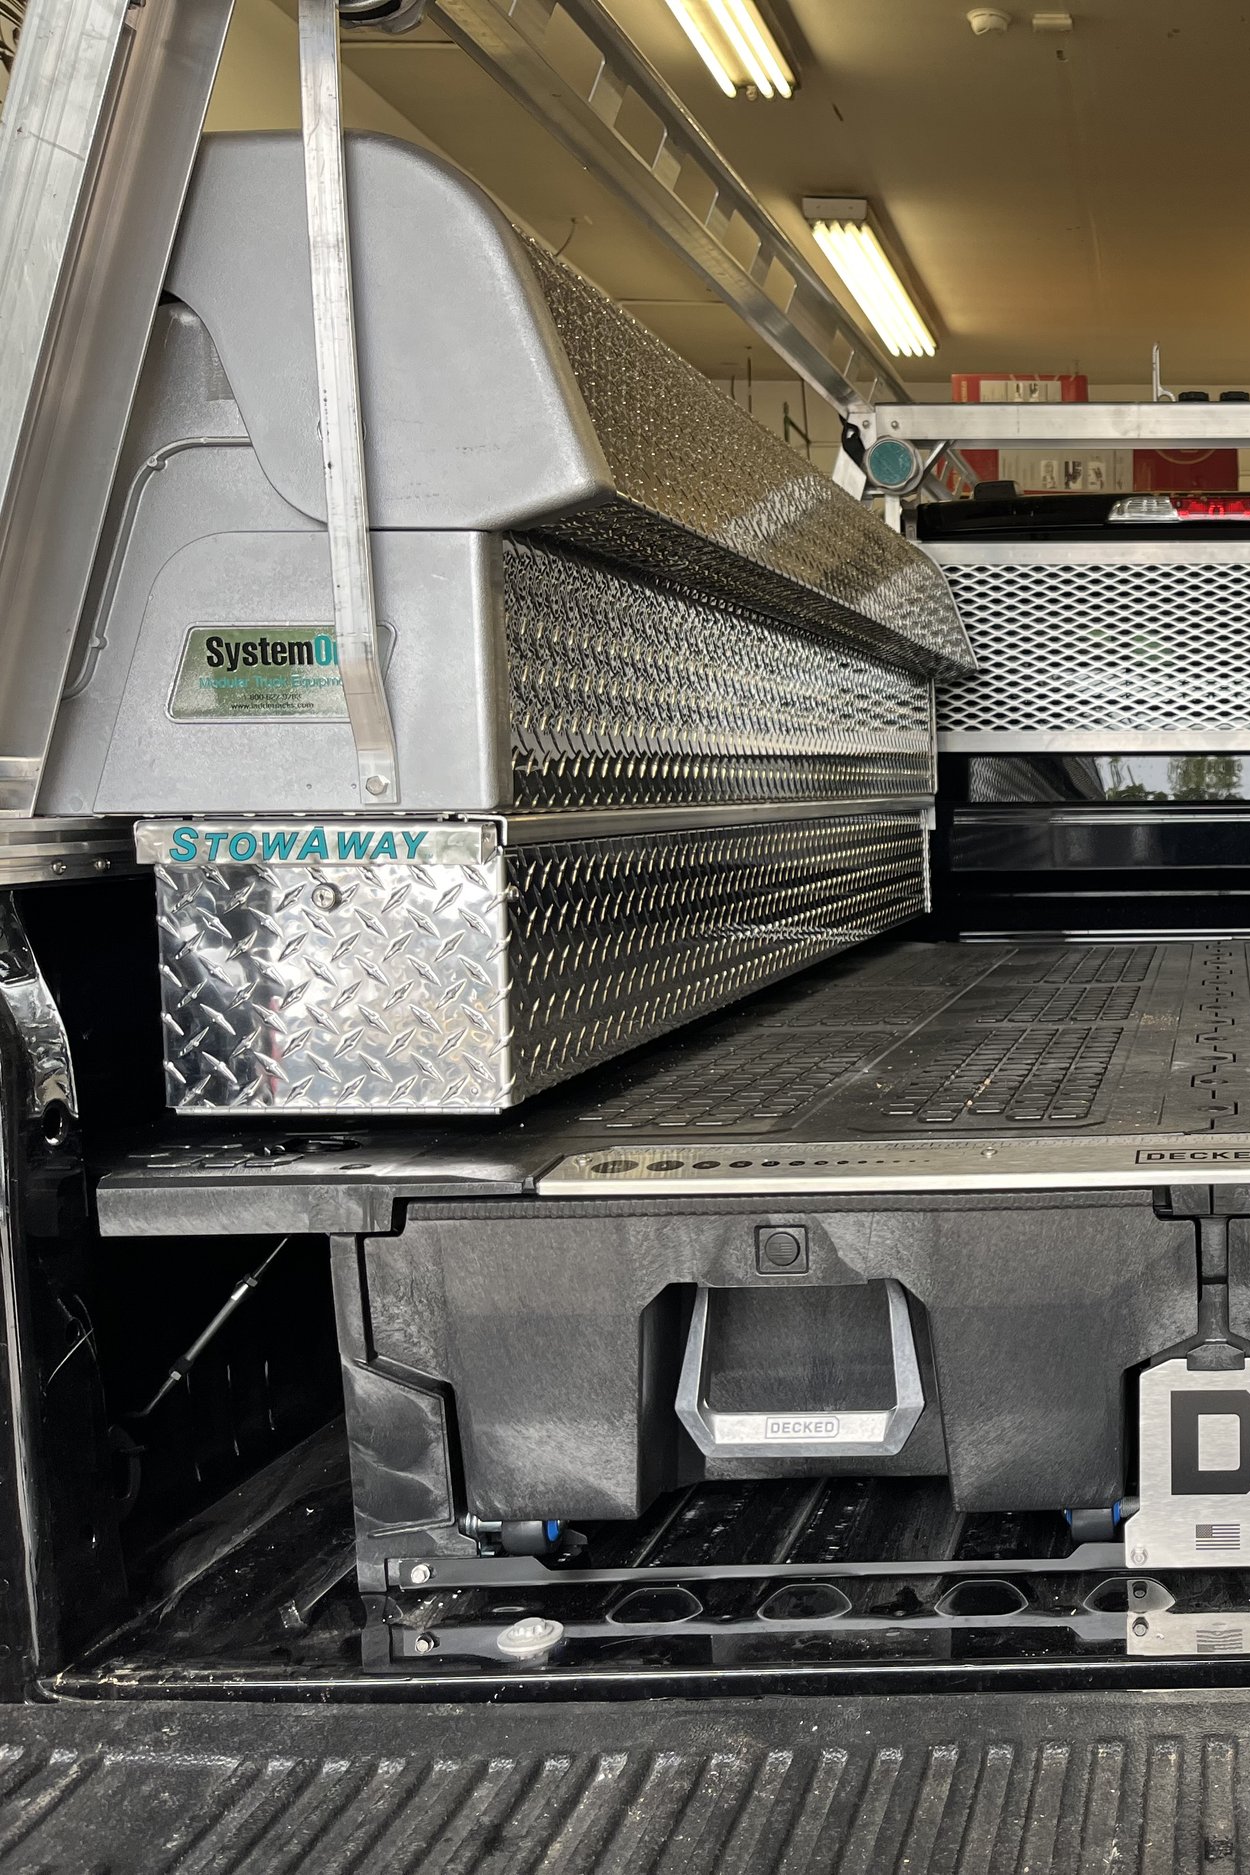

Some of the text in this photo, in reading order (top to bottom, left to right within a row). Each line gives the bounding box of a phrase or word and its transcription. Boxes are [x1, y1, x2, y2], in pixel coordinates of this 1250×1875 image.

[205, 634, 339, 672] SystemO
[254, 676, 288, 687] Truck
[291, 674, 343, 689] Equipm
[770, 1422, 835, 1434] DECKED
